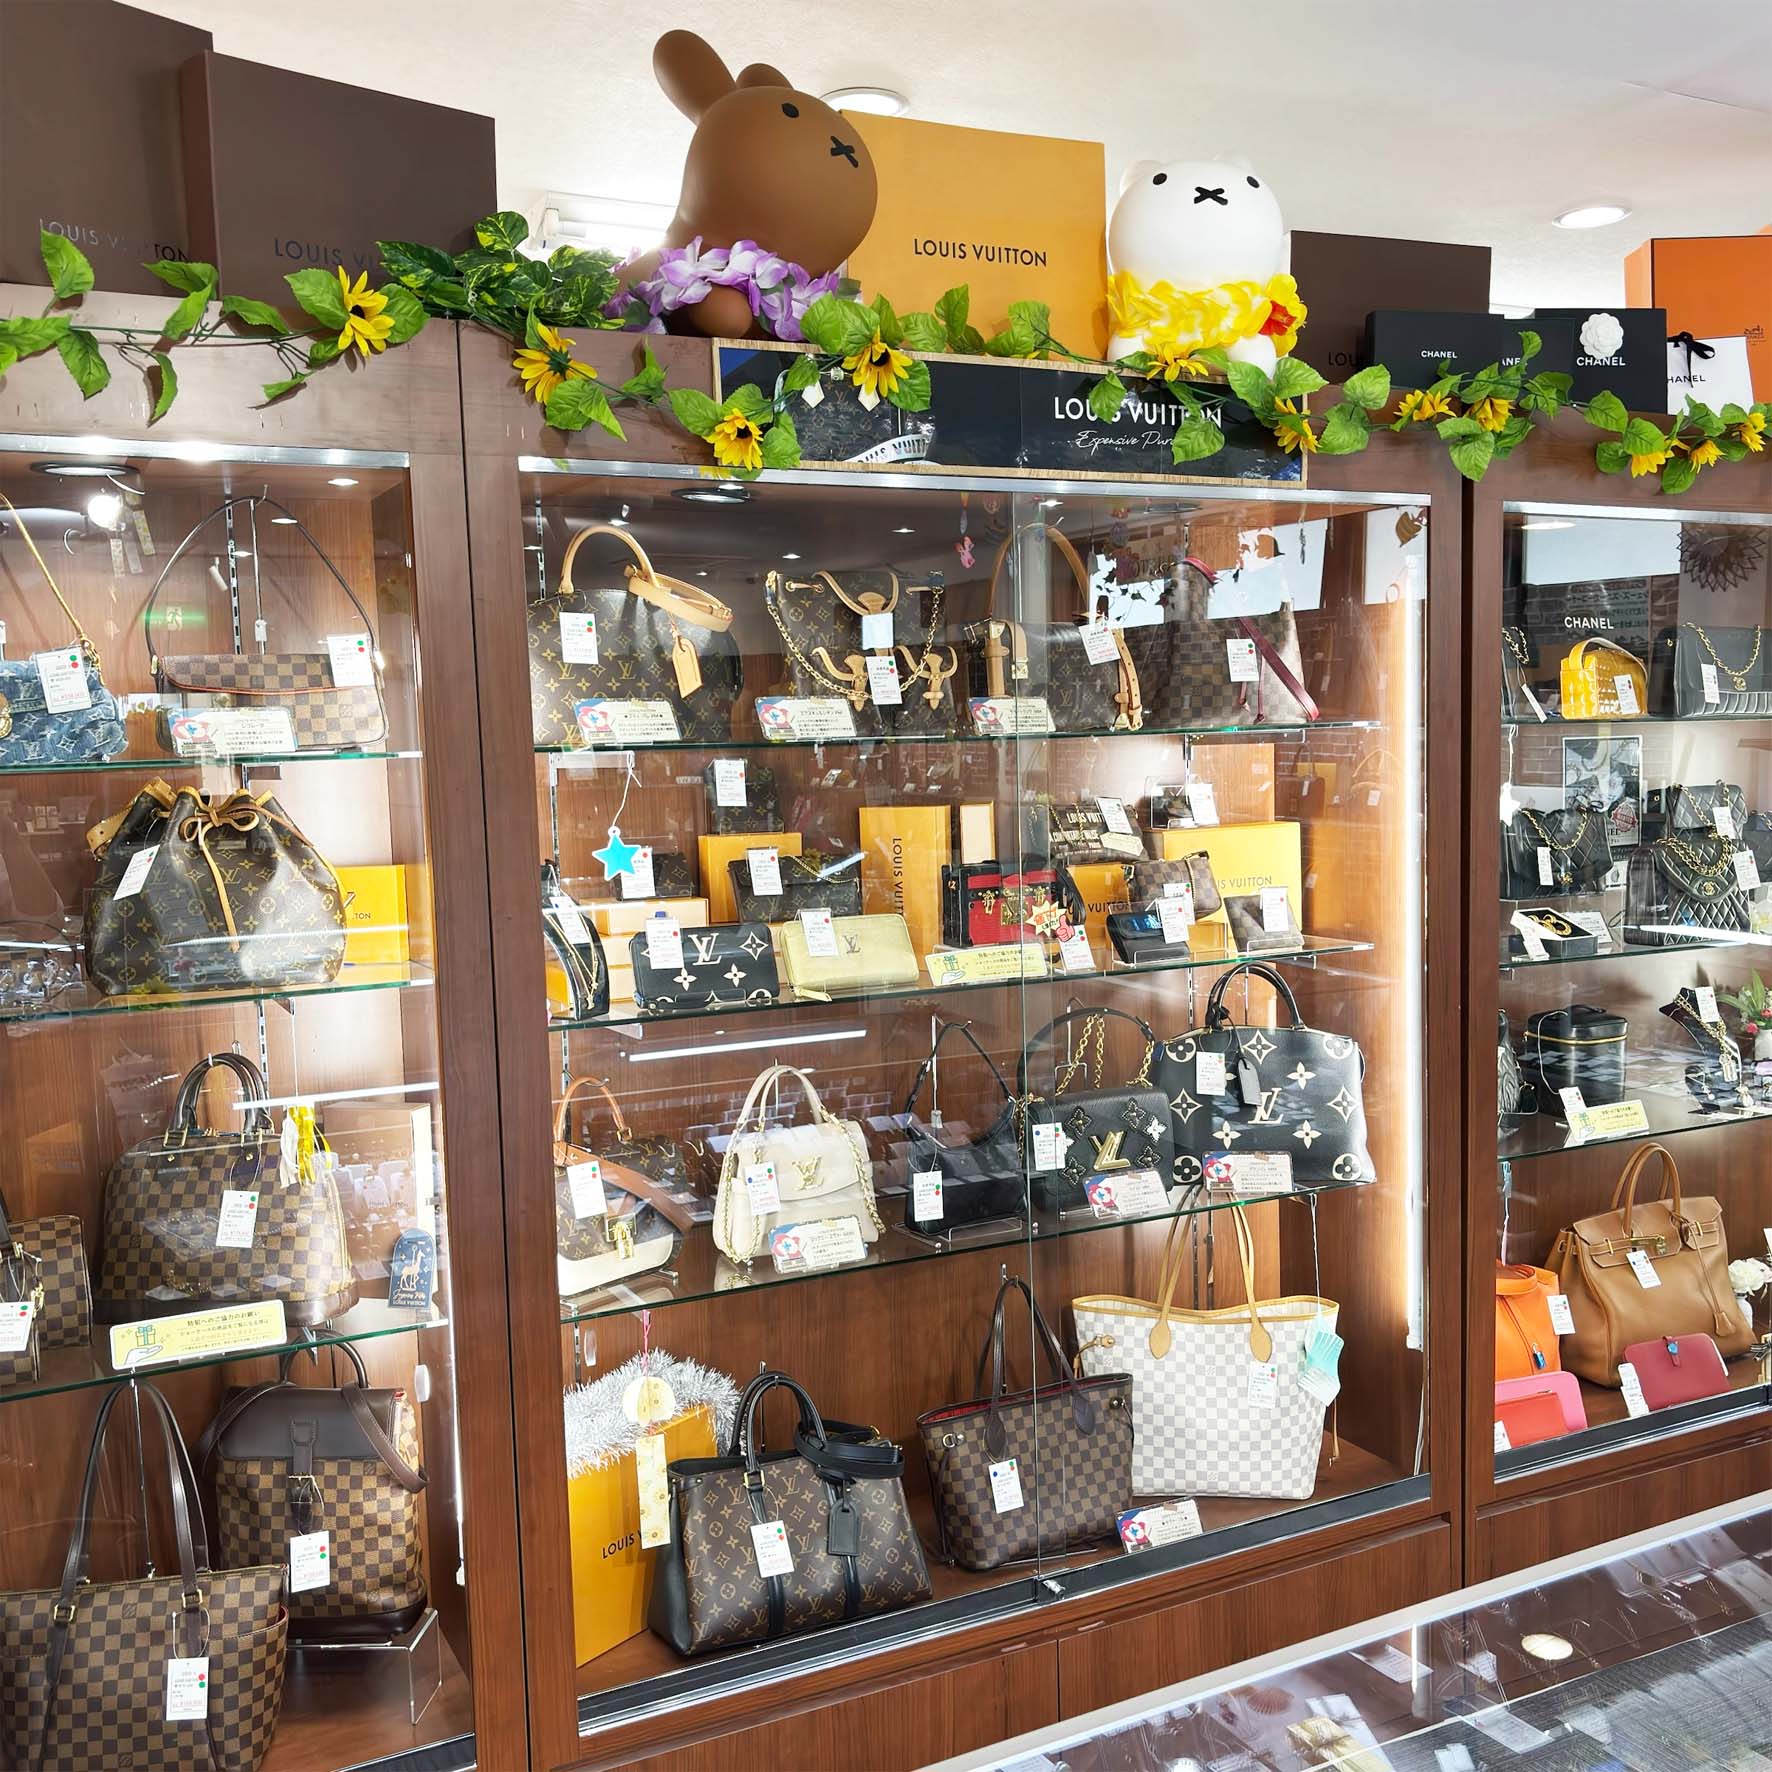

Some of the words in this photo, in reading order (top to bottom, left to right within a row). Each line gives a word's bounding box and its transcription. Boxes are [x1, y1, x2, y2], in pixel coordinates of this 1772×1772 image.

[274, 238, 343, 265] LOUIS
[914, 238, 967, 260] LOUIS
[972, 243, 1047, 267] VUITTON
[1420, 350, 1458, 359] CHANEL
[1576, 356, 1626, 366] CHANEL
[1667, 374, 1707, 384] HANEL
[1075, 430, 1140, 456] Expensive
[1564, 616, 1615, 630] CHANEL
[893, 838, 903, 877] LOUIS
[1229, 876, 1272, 889] VUITTON
[602, 1532, 635, 1560] LOUIS
